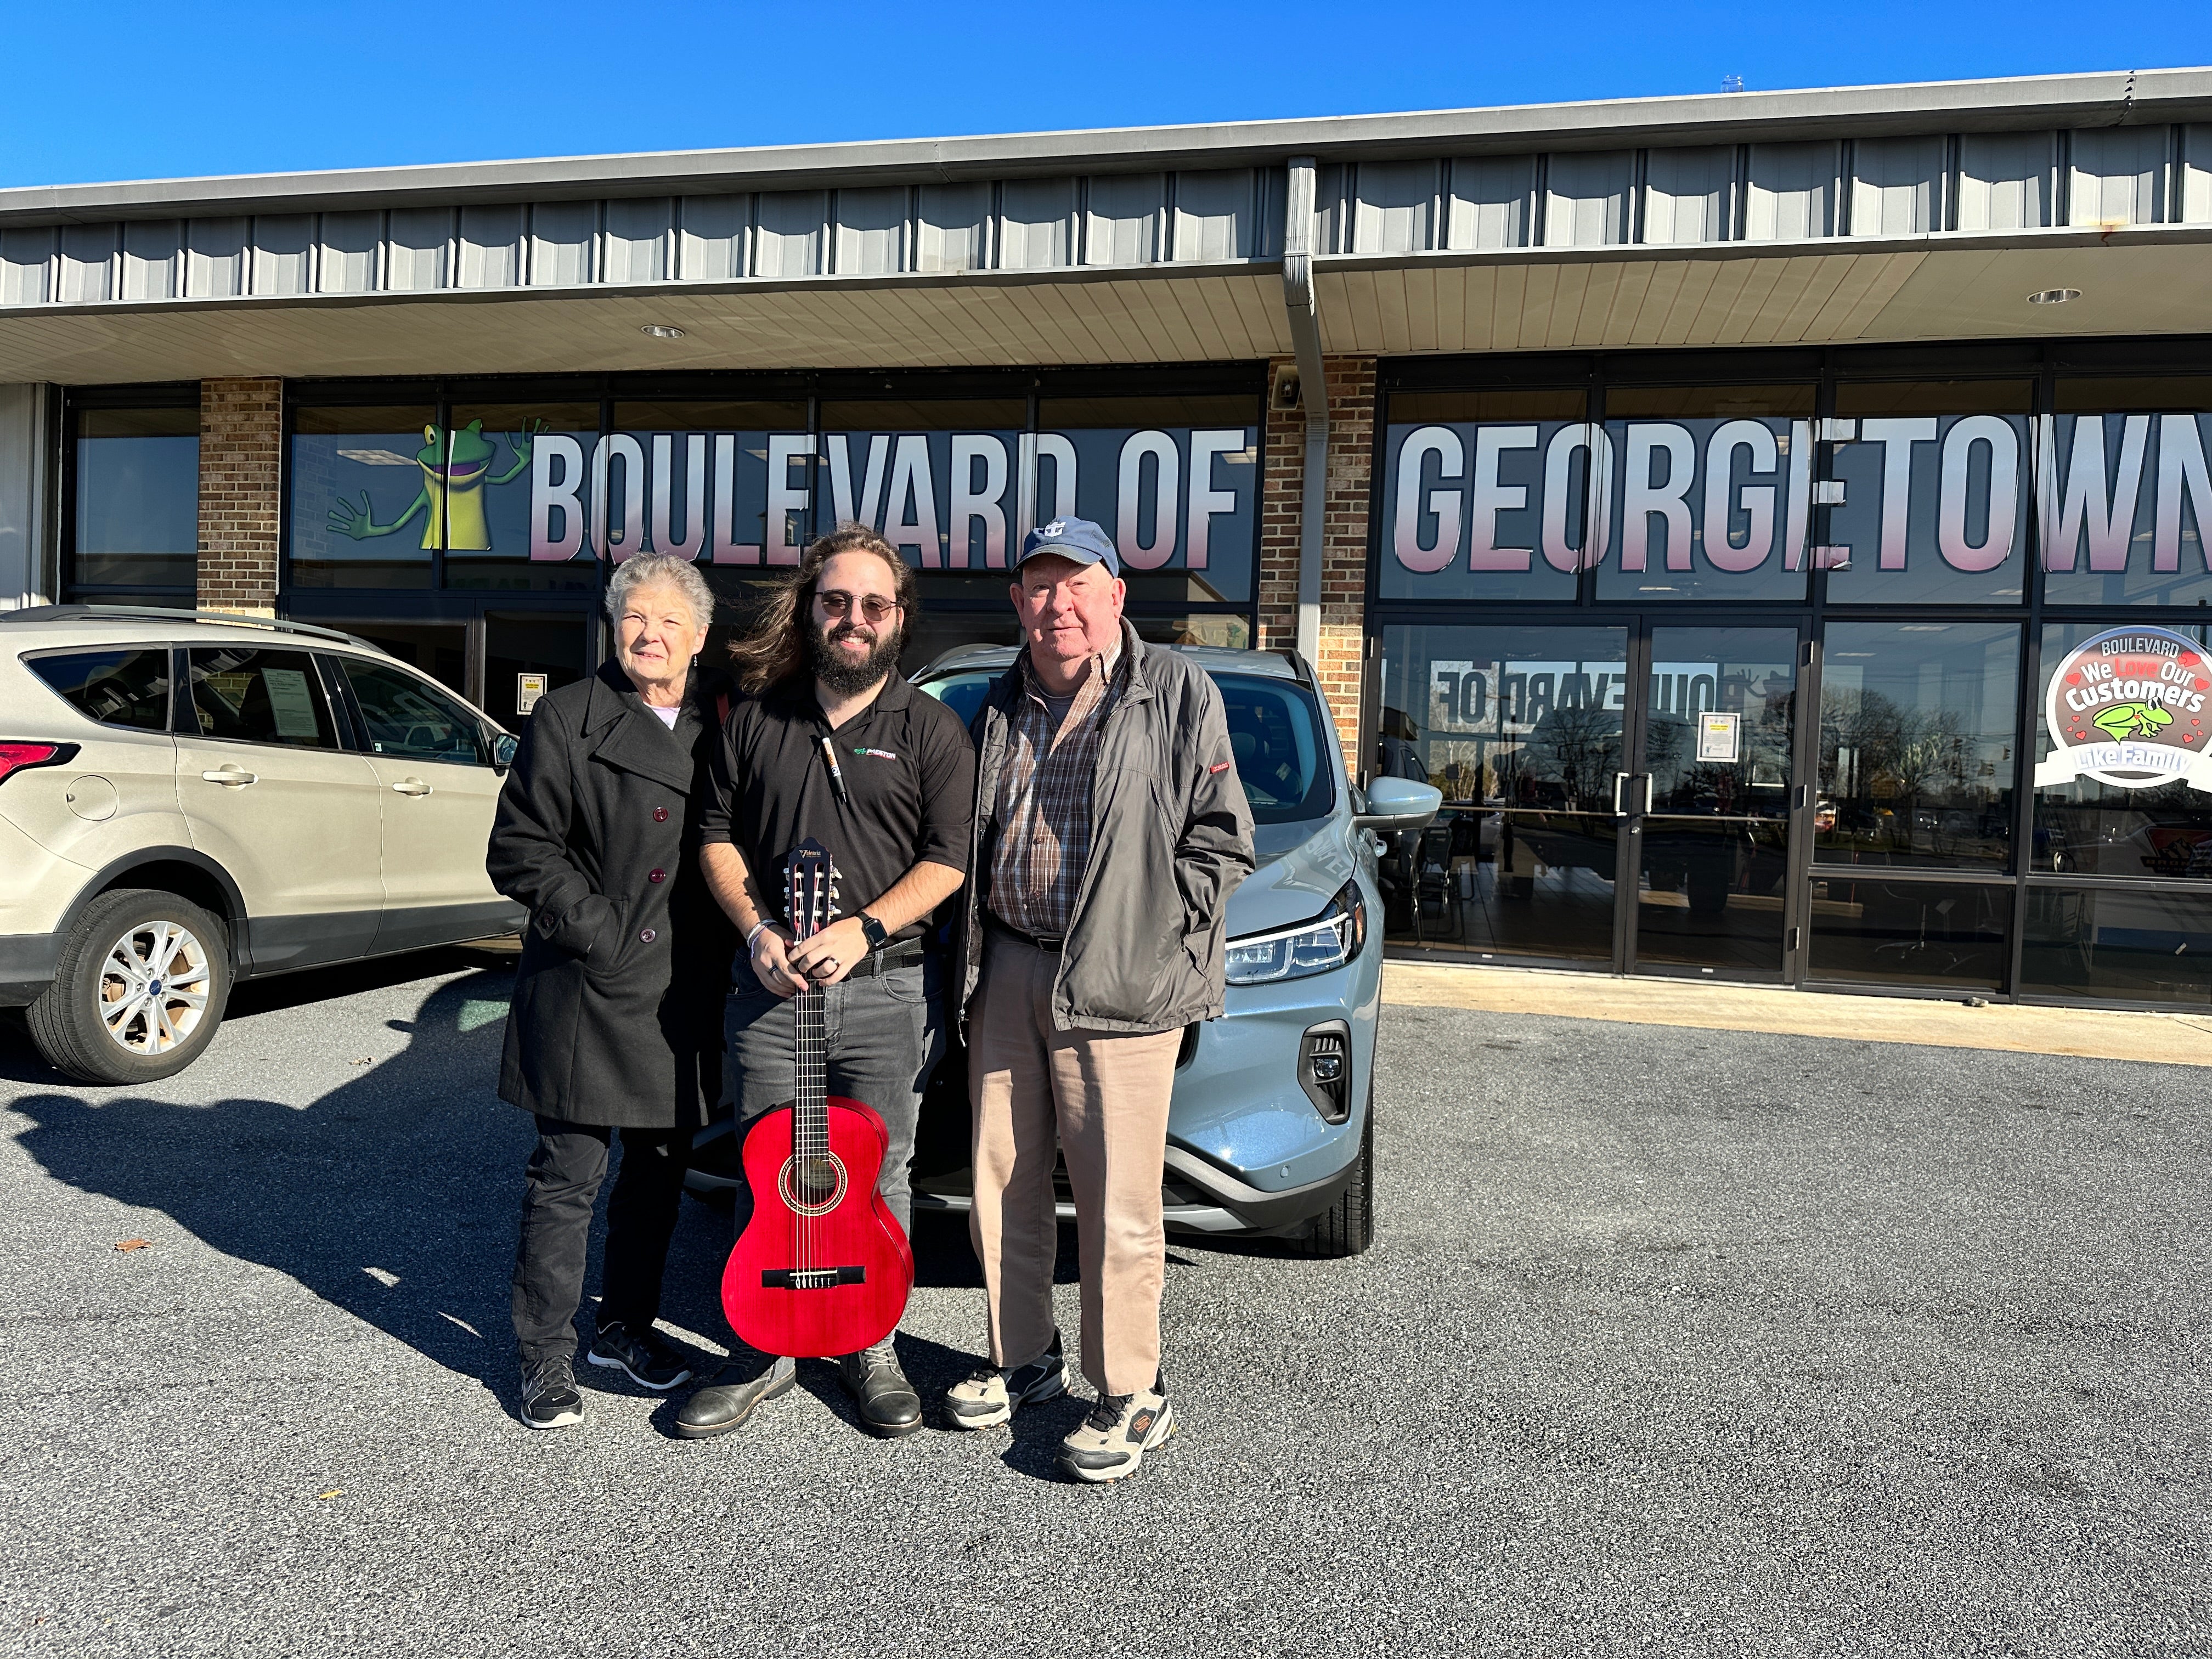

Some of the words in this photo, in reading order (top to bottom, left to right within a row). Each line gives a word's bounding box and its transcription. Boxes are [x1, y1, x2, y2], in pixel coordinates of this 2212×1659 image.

[530, 432, 1077, 569] BOULEVARD
[1118, 430, 1245, 569] OF
[1393, 414, 2212, 573] GEORGETOWN
[2101, 637, 2180, 659] BOULEVARD
[2081, 661, 2113, 684] We
[2115, 658, 2158, 678] Love
[2160, 661, 2196, 687] Our
[2065, 677, 2207, 713] Customers
[2074, 748, 2119, 769] Like
[2120, 744, 2193, 772] Family
